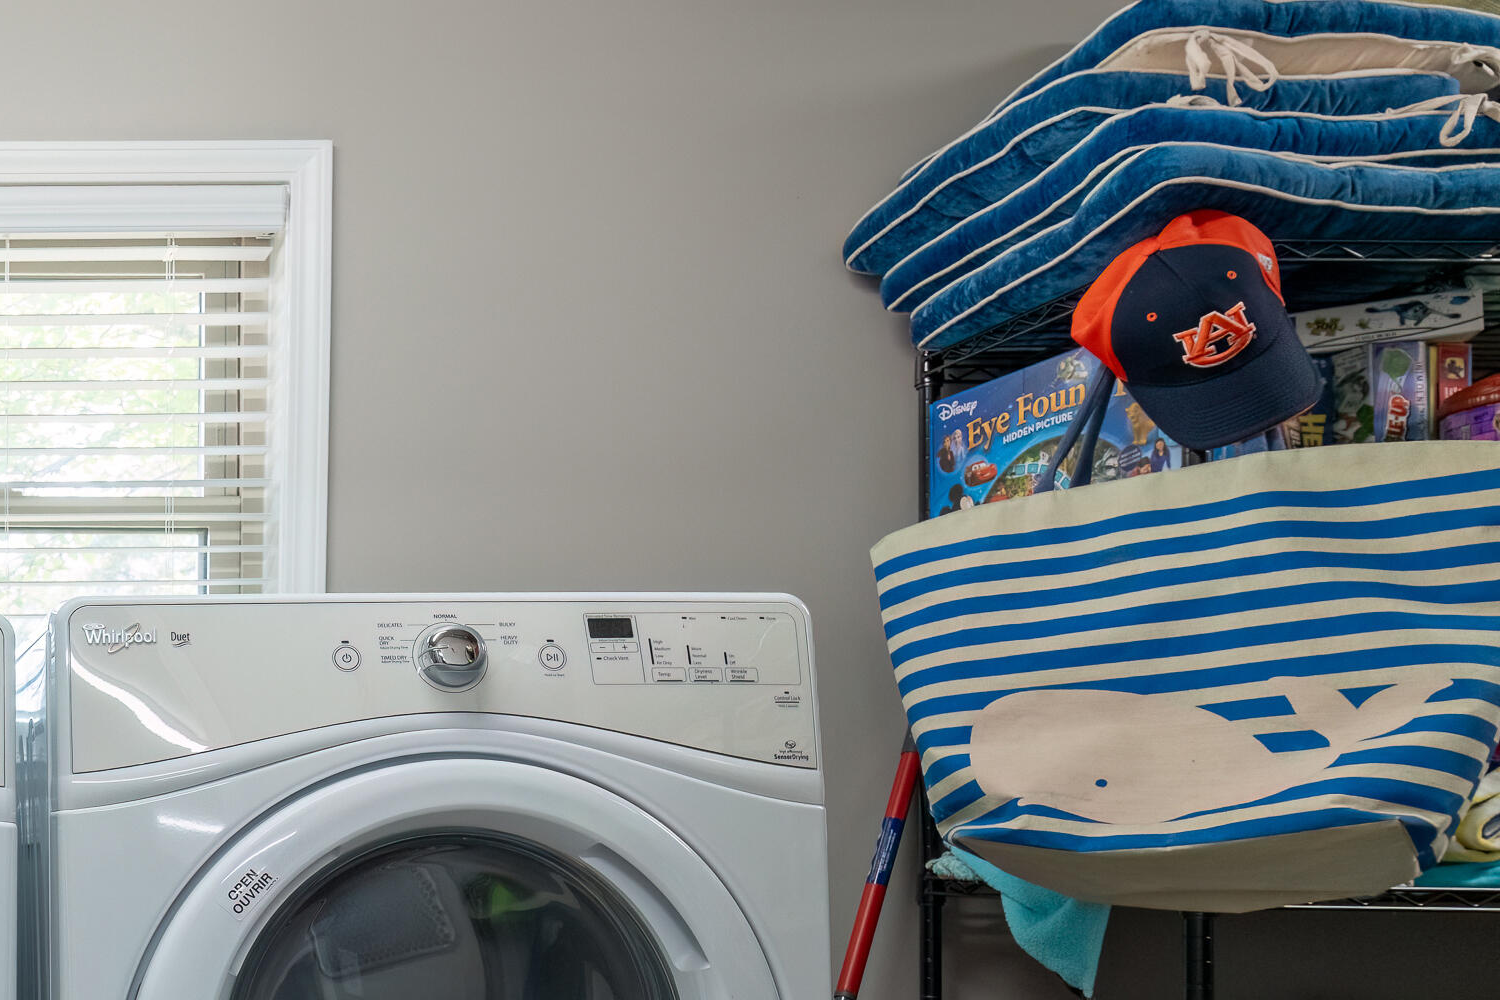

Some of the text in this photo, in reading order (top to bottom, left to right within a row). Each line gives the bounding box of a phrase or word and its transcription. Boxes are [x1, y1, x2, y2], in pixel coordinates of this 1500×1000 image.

[966, 383, 1087, 451] Eye Foun
[1002, 411, 1074, 446] HIDDEN PICTURE
[83, 625, 157, 649] Whirlpool
[170, 631, 191, 643] Duet
[228, 868, 258, 901] OPEN
[233, 873, 273, 914] OUVRIR
